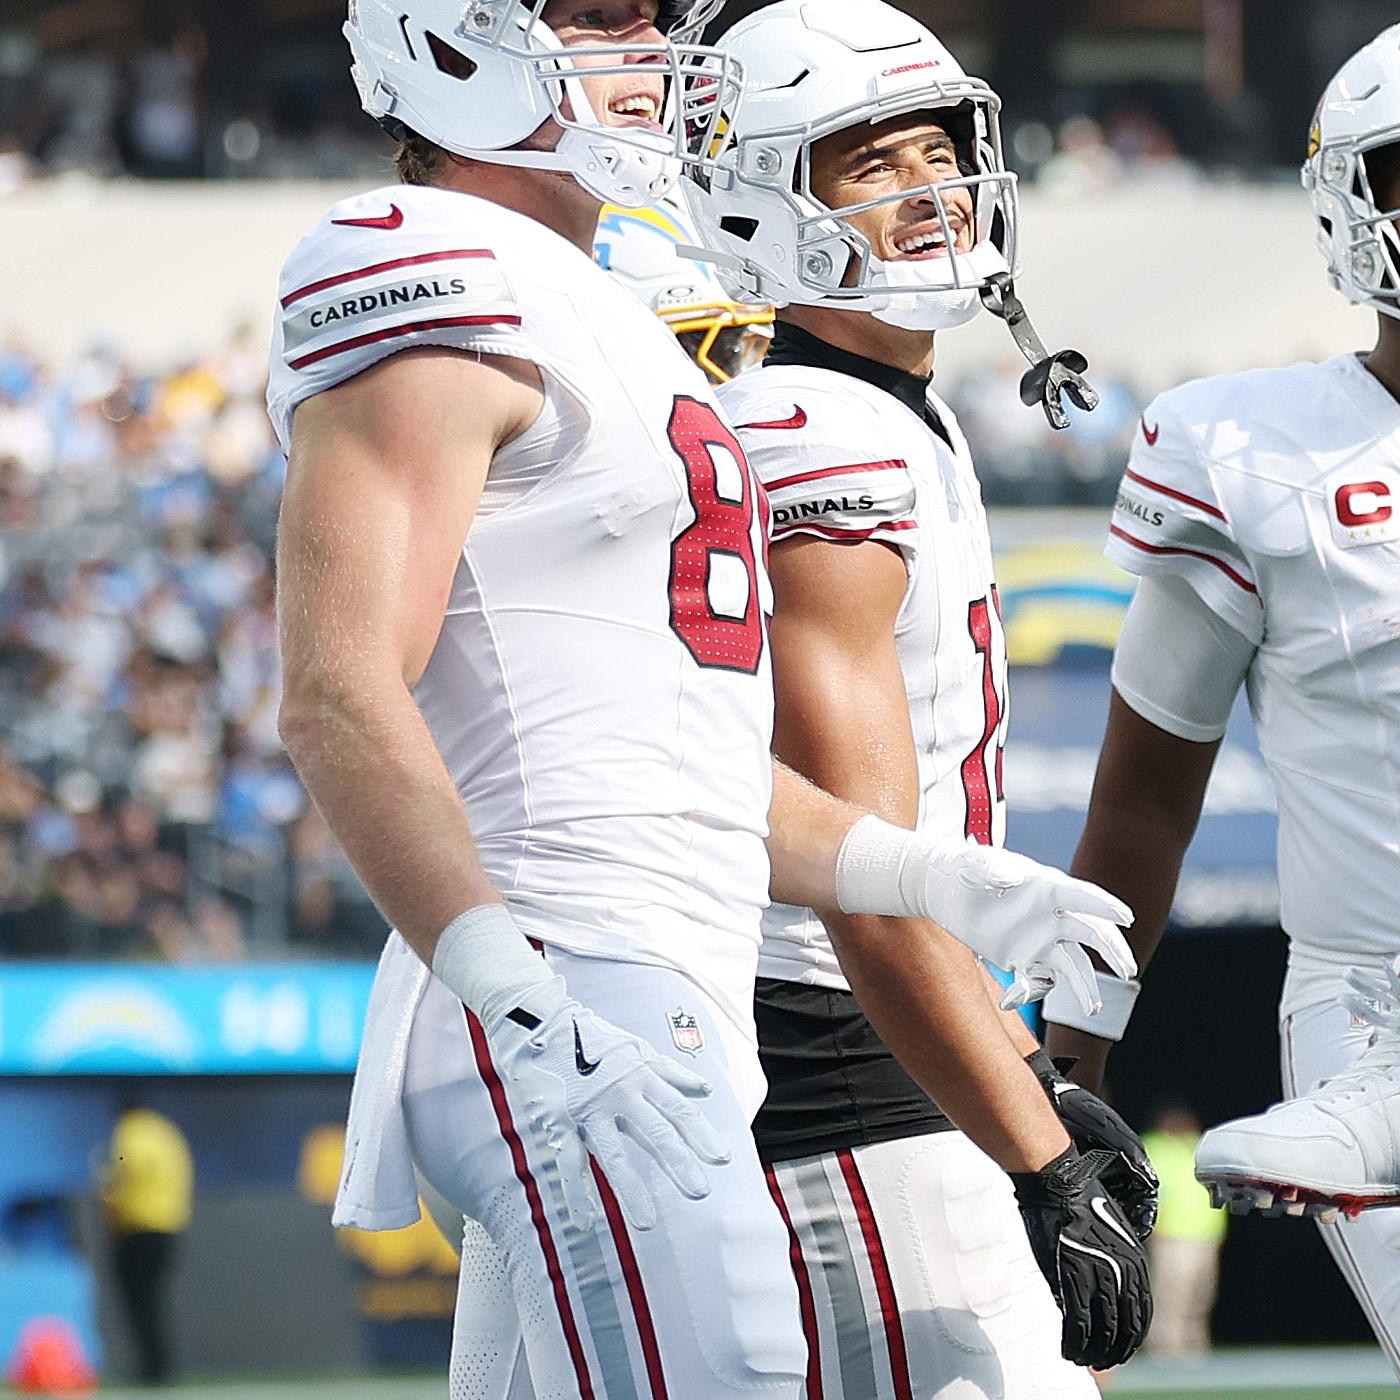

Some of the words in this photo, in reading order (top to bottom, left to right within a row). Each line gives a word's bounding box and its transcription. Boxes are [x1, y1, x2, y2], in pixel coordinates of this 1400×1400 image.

[310, 279, 466, 328] CARDINALS
[773, 495, 875, 522] DINALS
[1118, 494, 1165, 527] DINALS
[1336, 481, 1393, 527] C
[667, 394, 775, 677] 8
